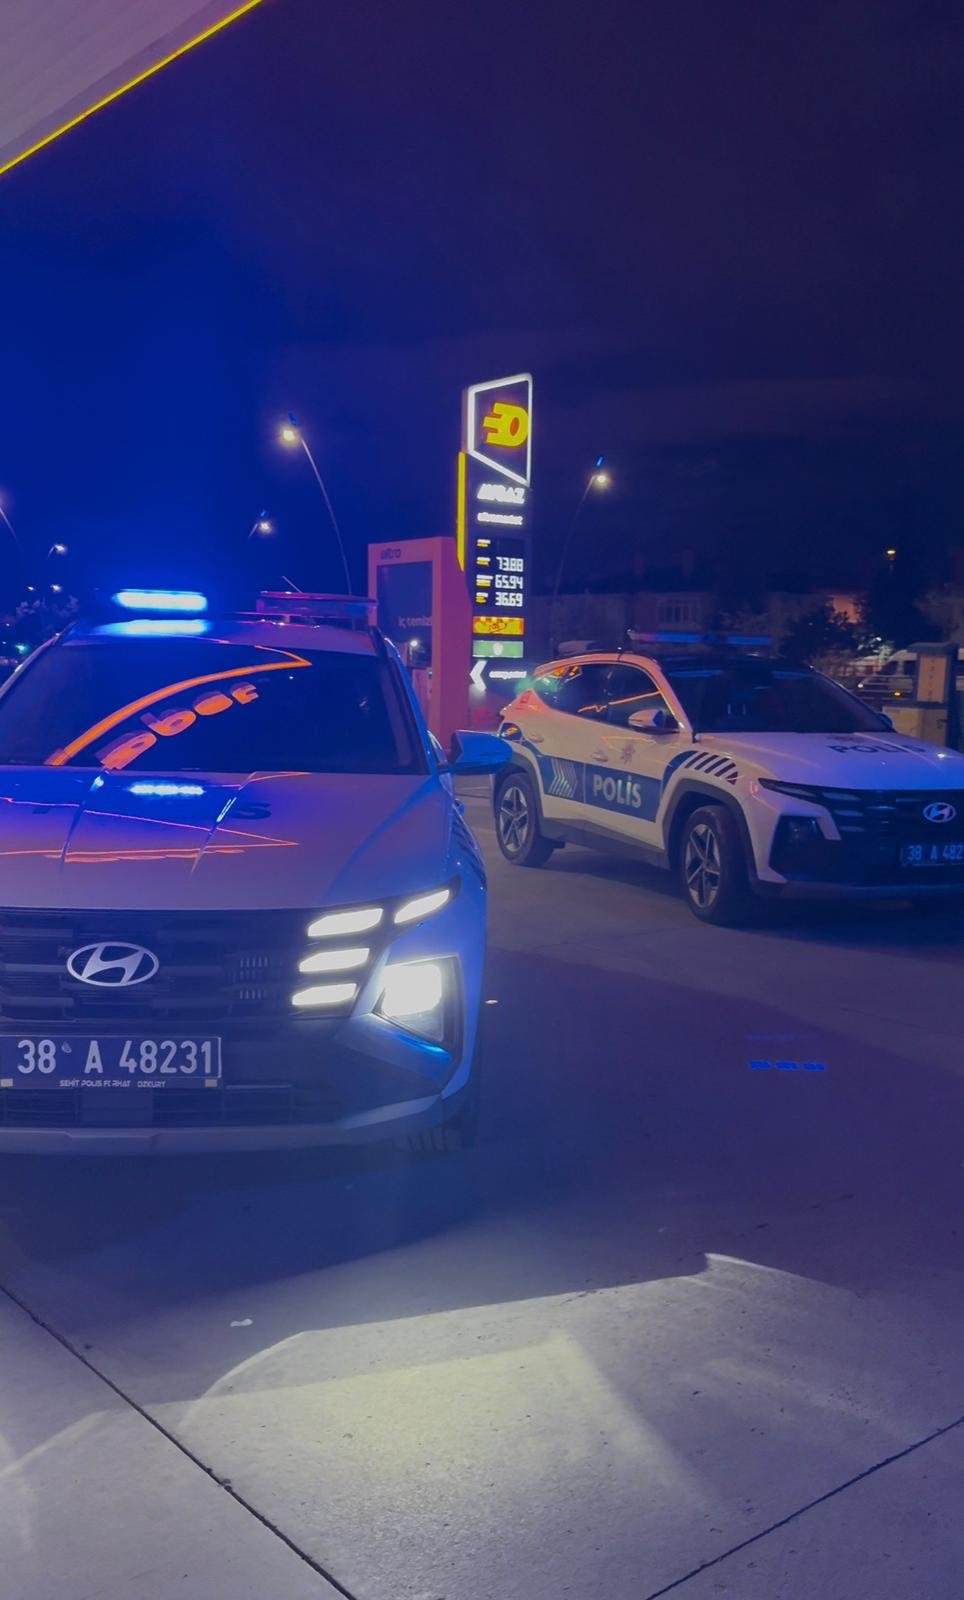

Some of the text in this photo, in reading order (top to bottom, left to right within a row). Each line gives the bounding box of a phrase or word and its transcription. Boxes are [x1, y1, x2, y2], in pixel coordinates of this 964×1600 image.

[592, 773, 642, 809] POLİS
[907, 845, 922, 861] 38
[930, 845, 938, 860] A
[17, 1039, 211, 1074] 38 A 48231
